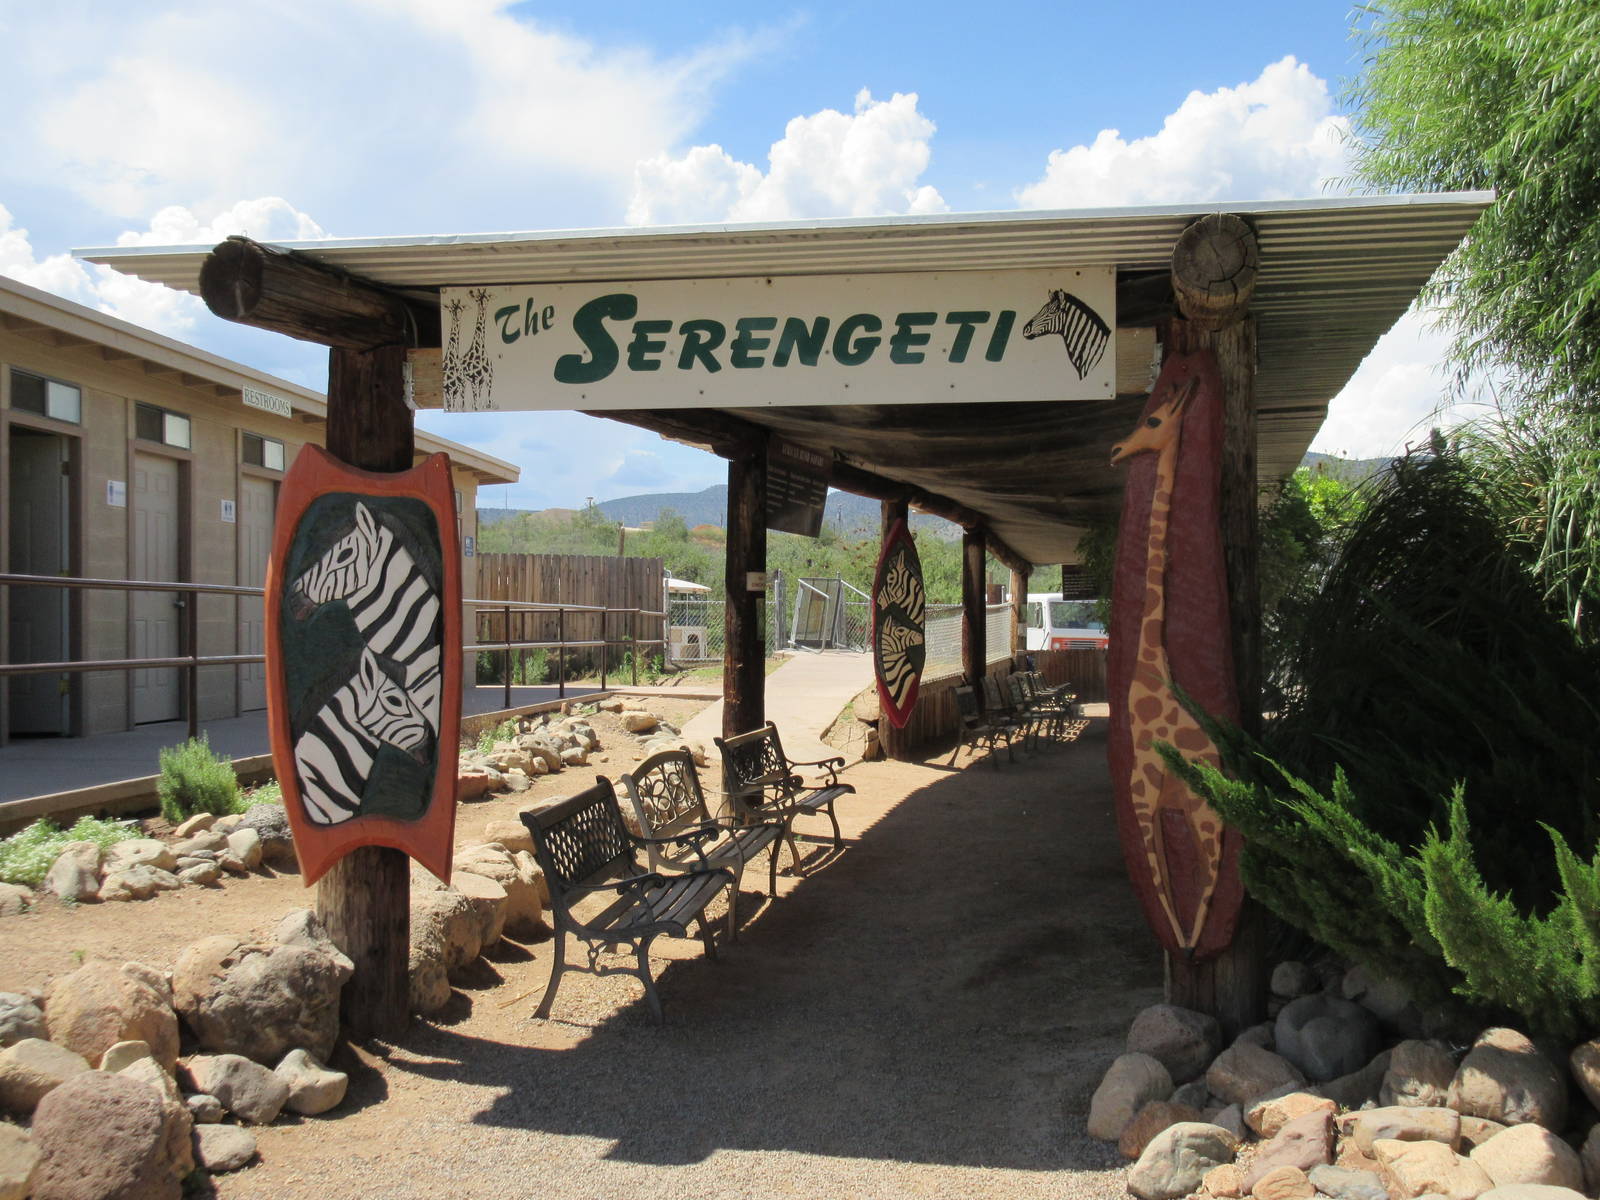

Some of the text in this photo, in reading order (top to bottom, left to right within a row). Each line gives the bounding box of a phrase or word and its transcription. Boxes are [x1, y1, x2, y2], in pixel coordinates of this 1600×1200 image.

[494, 293, 1016, 384] The SERENGETI
[244, 388, 290, 416] RESTROOMS
